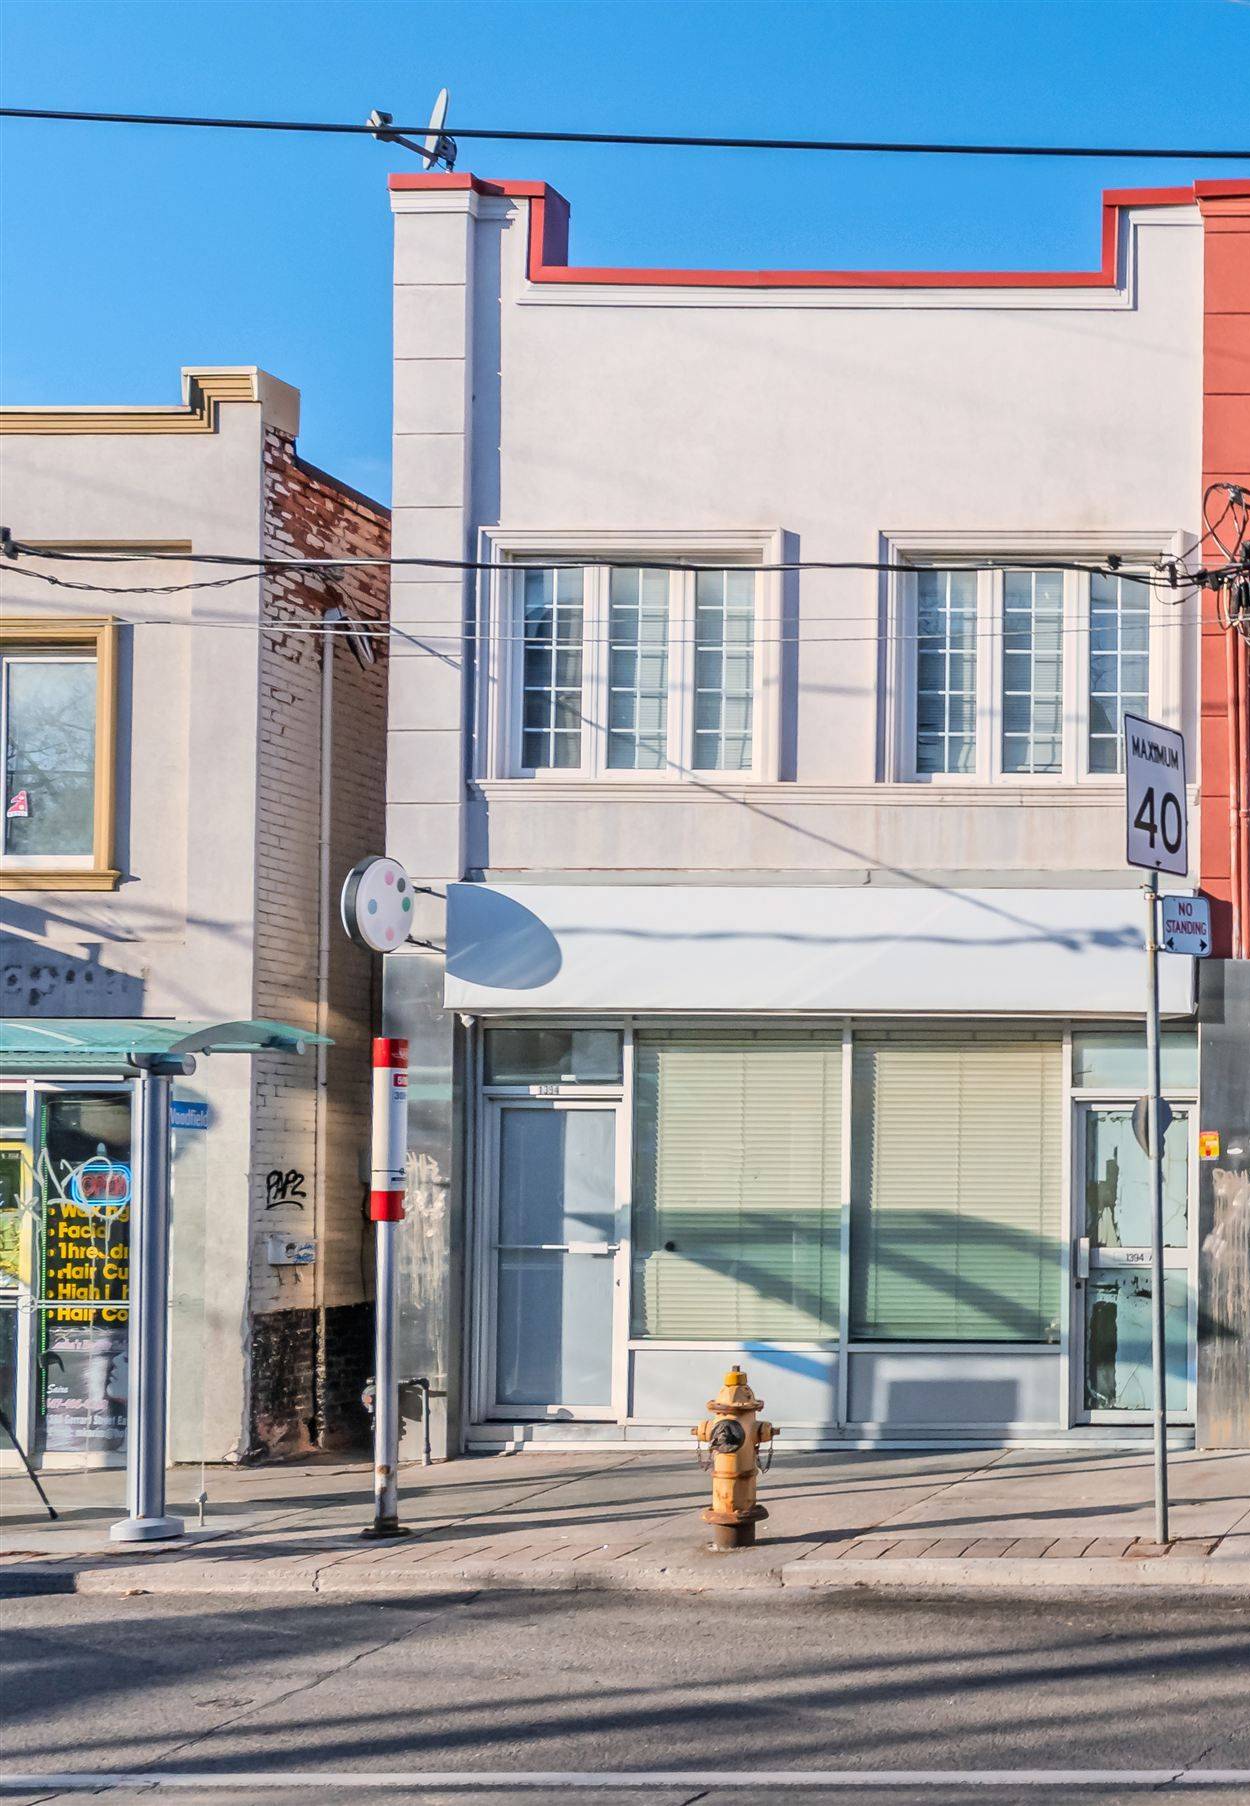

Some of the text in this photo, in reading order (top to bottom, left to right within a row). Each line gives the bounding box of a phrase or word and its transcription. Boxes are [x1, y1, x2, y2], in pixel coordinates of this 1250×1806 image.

[1132, 735, 1179, 770] MAXIMUM
[1134, 786, 1182, 854] 40
[1178, 902, 1193, 917] NO
[1165, 919, 1207, 936] STANDING
